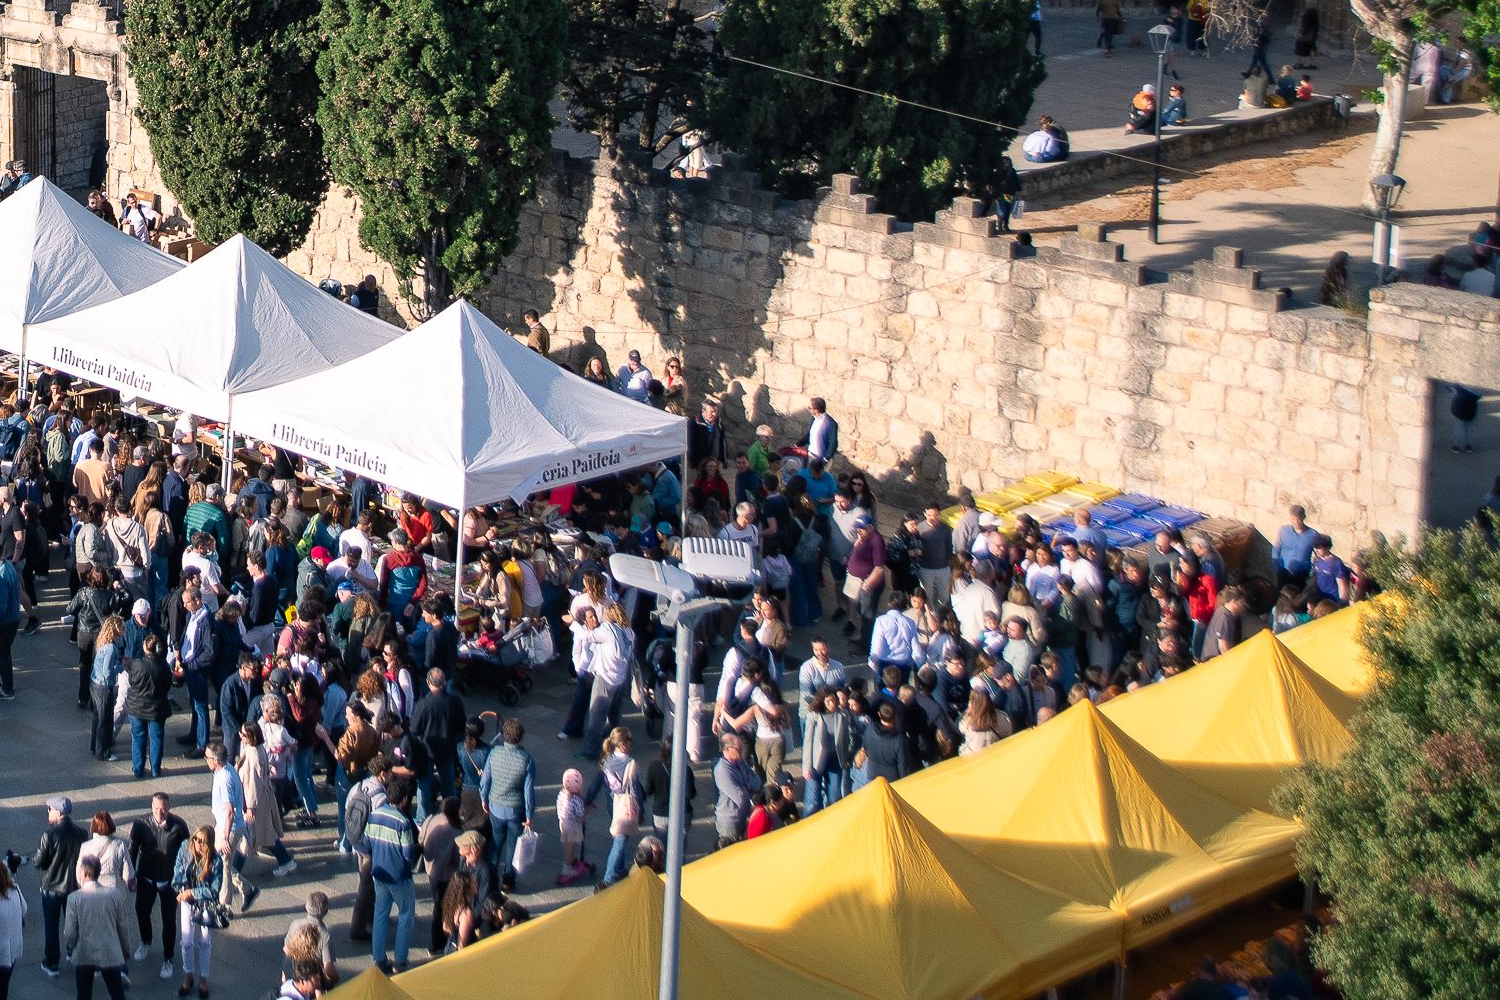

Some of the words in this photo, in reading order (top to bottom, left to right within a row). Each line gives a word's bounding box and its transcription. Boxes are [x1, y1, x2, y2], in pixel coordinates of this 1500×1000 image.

[52, 346, 104, 376] Llibreria
[107, 364, 152, 393] Paideia
[271, 423, 331, 456] Llibreria
[335, 444, 387, 475] Paideia
[536, 462, 569, 485] eria
[572, 449, 621, 475] Paideia
